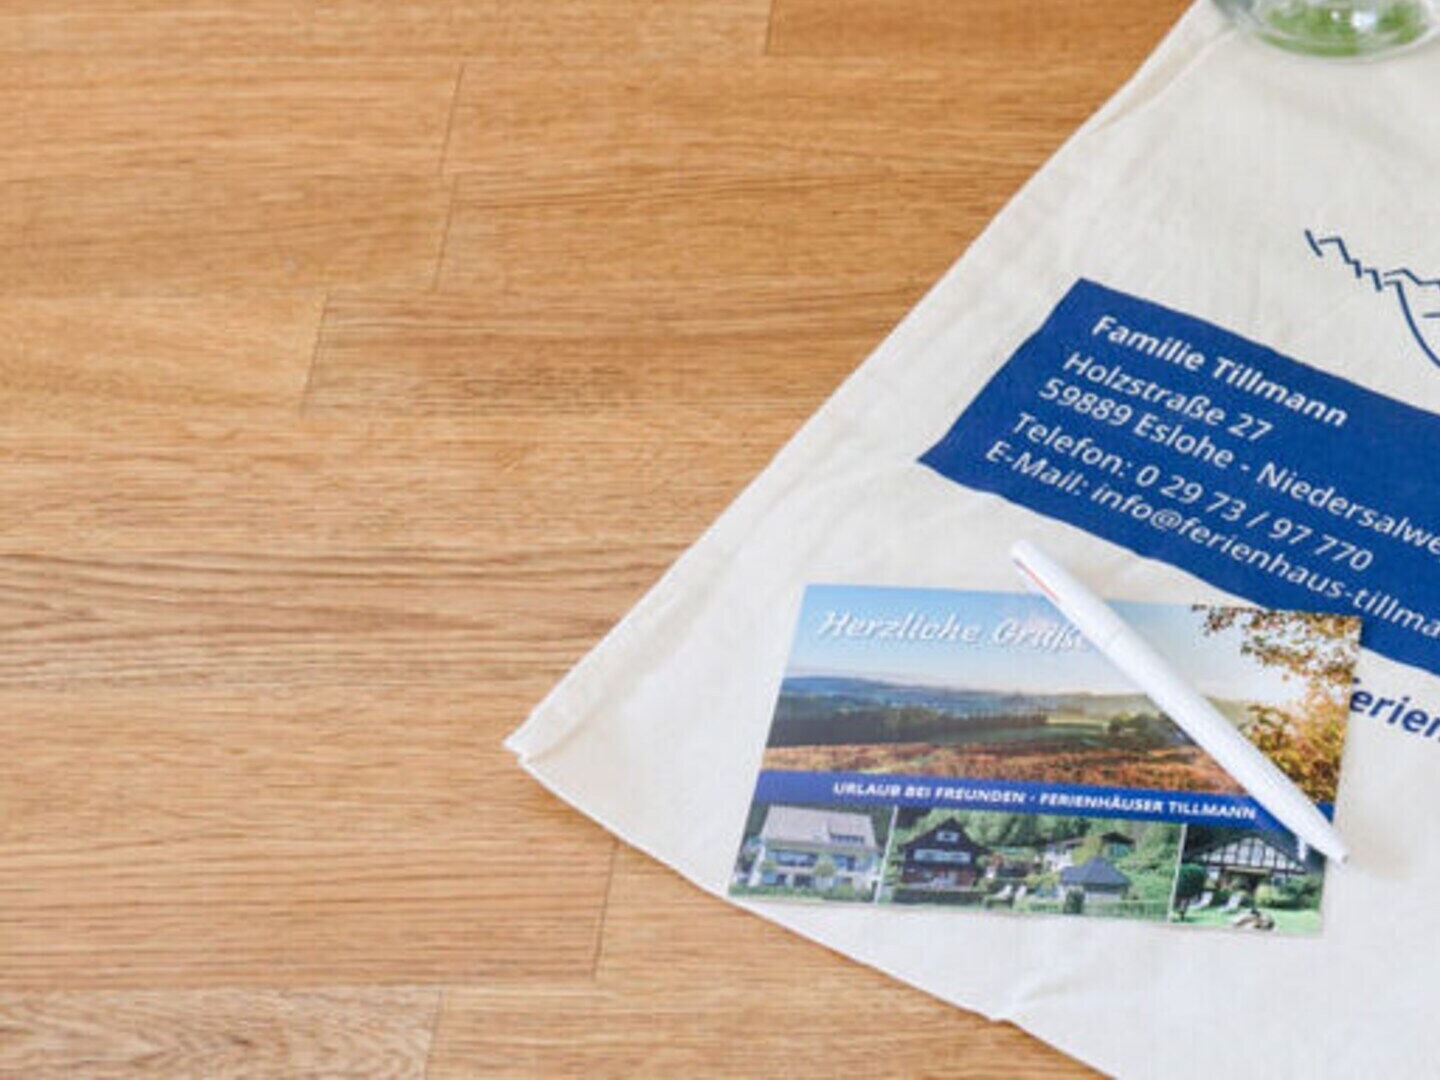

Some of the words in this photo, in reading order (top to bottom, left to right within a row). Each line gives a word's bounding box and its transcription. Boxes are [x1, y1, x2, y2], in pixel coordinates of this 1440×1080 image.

[1063, 351, 1225, 426] Holzstraße
[1227, 412, 1274, 441] 27
[1091, 315, 1206, 371] Familie
[1211, 356, 1348, 427] Tillmann
[986, 440, 1089, 497] E-Mail:
[1038, 377, 1133, 426] 59889
[1133, 412, 1234, 470] Eslohe
[1013, 411, 1133, 478] Telefon:
[1135, 464, 1160, 488] 0
[1160, 475, 1204, 505] 29
[1205, 491, 1247, 522] 73
[1246, 511, 1271, 529] /
[1269, 517, 1314, 546] 97
[1314, 533, 1374, 571] 770
[817, 607, 981, 644] Herzliche
[833, 781, 901, 798] URLAUB
[904, 785, 931, 799] BEI
[935, 786, 1026, 805] FREUNDEN
[1039, 791, 1165, 815] FERIENHÄUSER
[1168, 800, 1256, 819] TILLMANN
